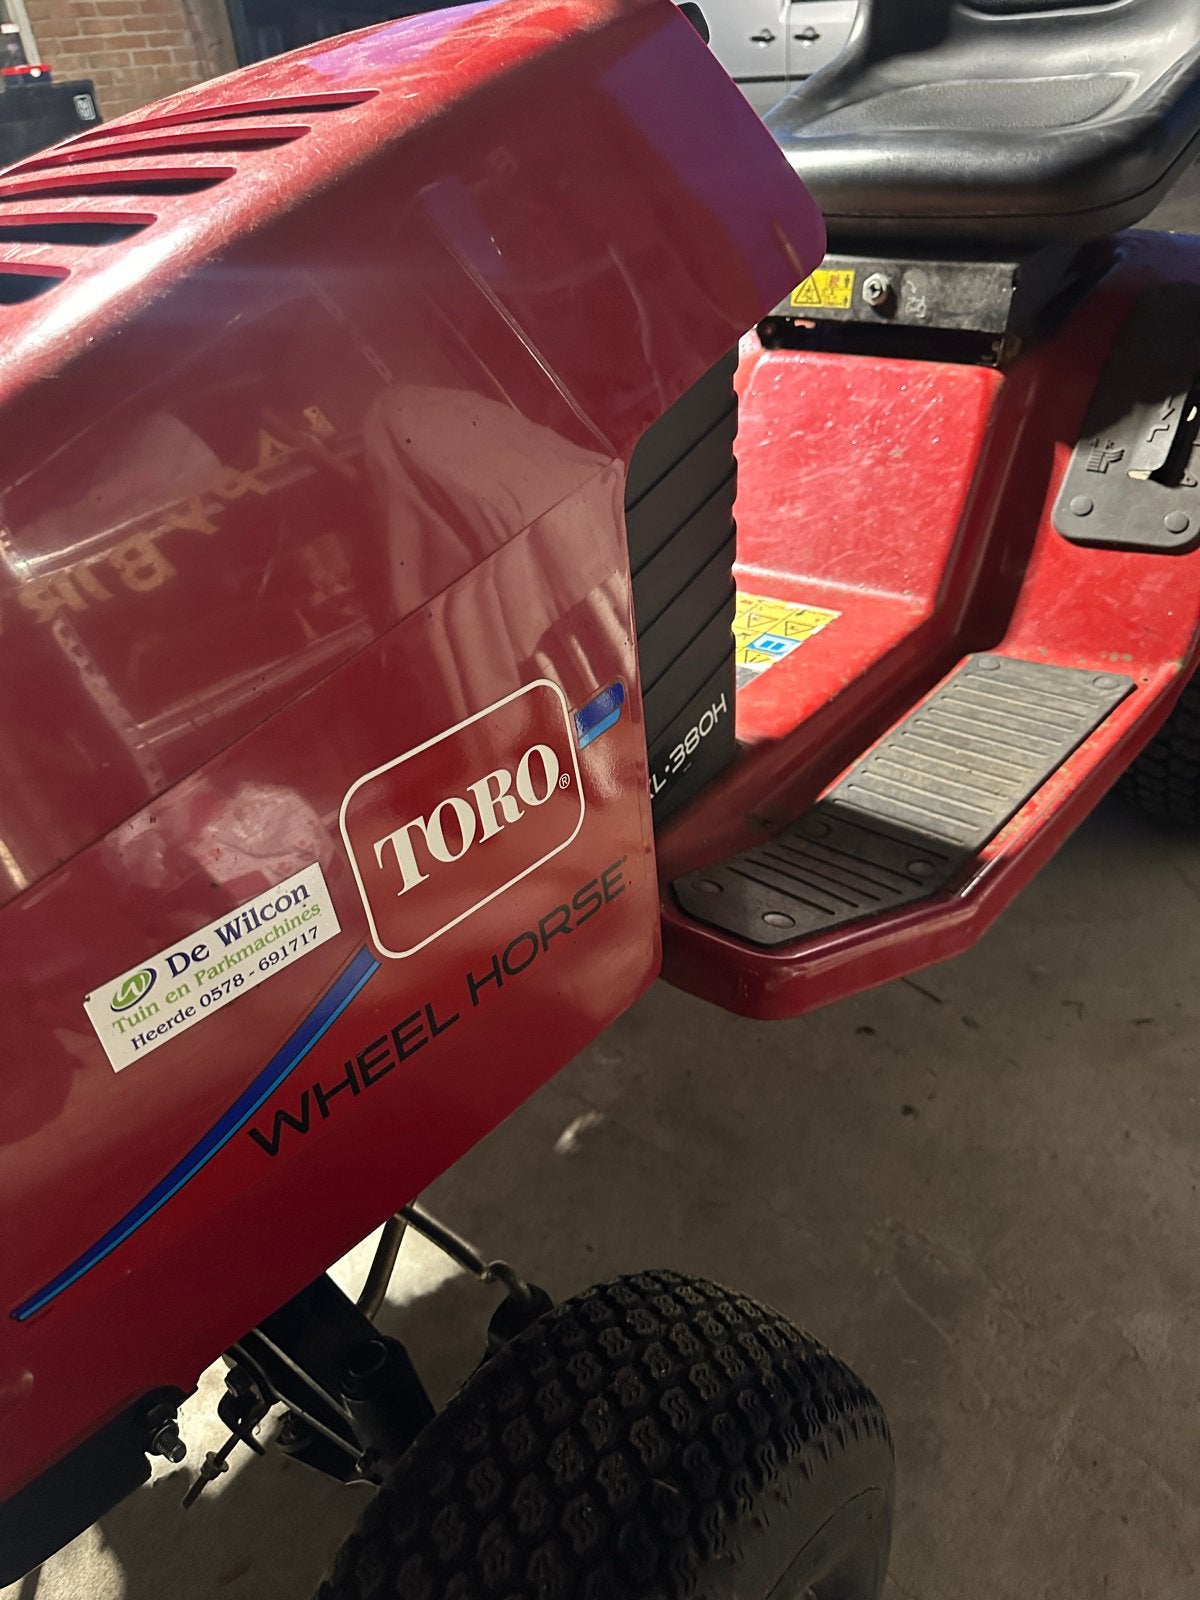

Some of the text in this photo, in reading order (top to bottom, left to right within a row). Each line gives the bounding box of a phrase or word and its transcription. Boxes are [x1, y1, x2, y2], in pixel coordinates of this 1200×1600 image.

[112, 903, 321, 1035] Tuin en Parkmachines
[131, 1005, 196, 1051] Heerde
[199, 973, 246, 1008] 0578
[258, 925, 319, 972] 691717
[165, 883, 311, 978] De Wilcon
[246, 857, 625, 1157] WHEEL HORSE
